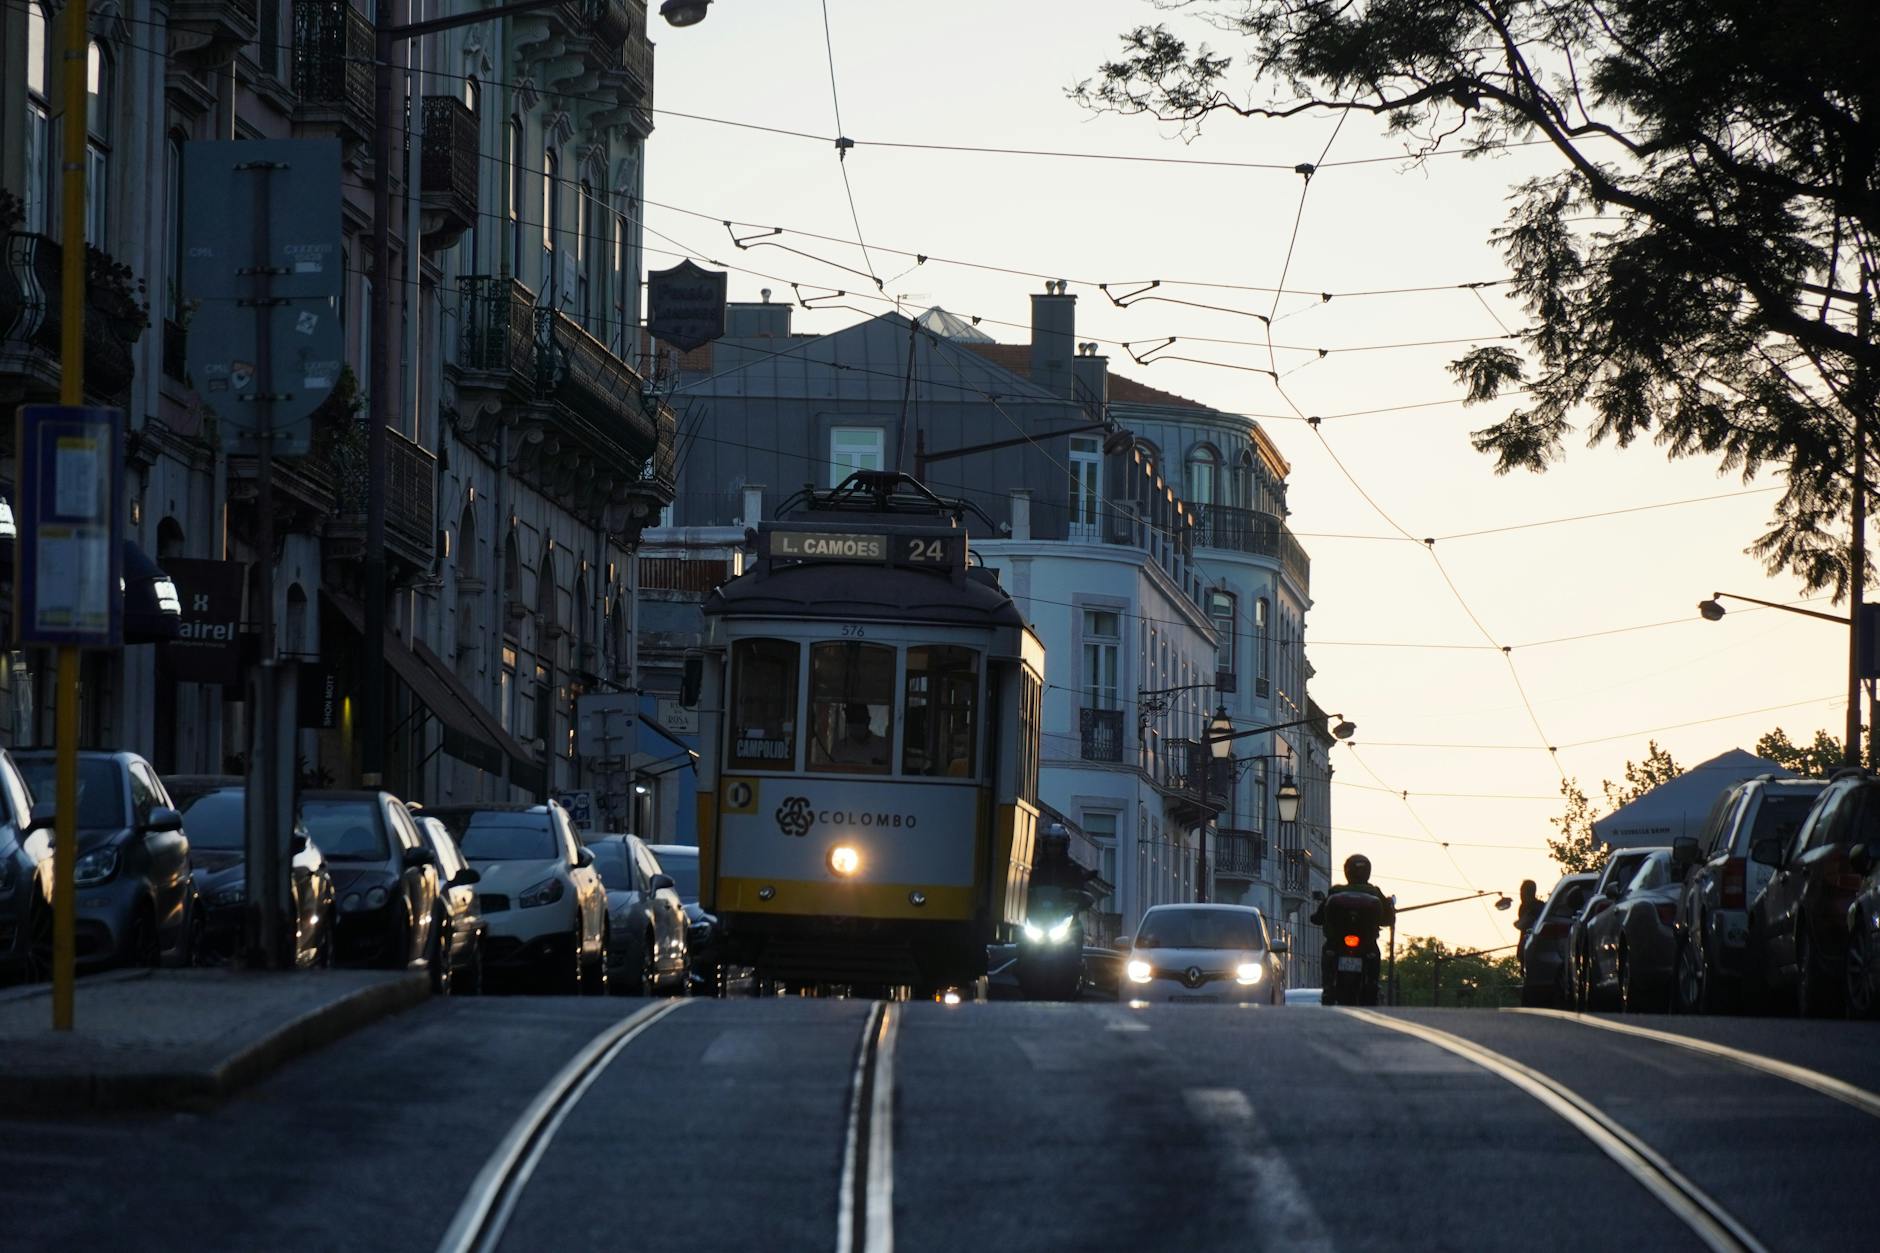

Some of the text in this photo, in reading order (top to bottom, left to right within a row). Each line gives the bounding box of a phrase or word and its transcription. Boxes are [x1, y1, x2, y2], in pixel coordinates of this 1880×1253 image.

[783, 537, 798, 552] L.
[909, 539, 943, 562] 24
[179, 620, 235, 641] airel
[841, 625, 864, 637] 576
[736, 739, 790, 759] CAMPOLIDE
[819, 810, 917, 829] COLOMBO
